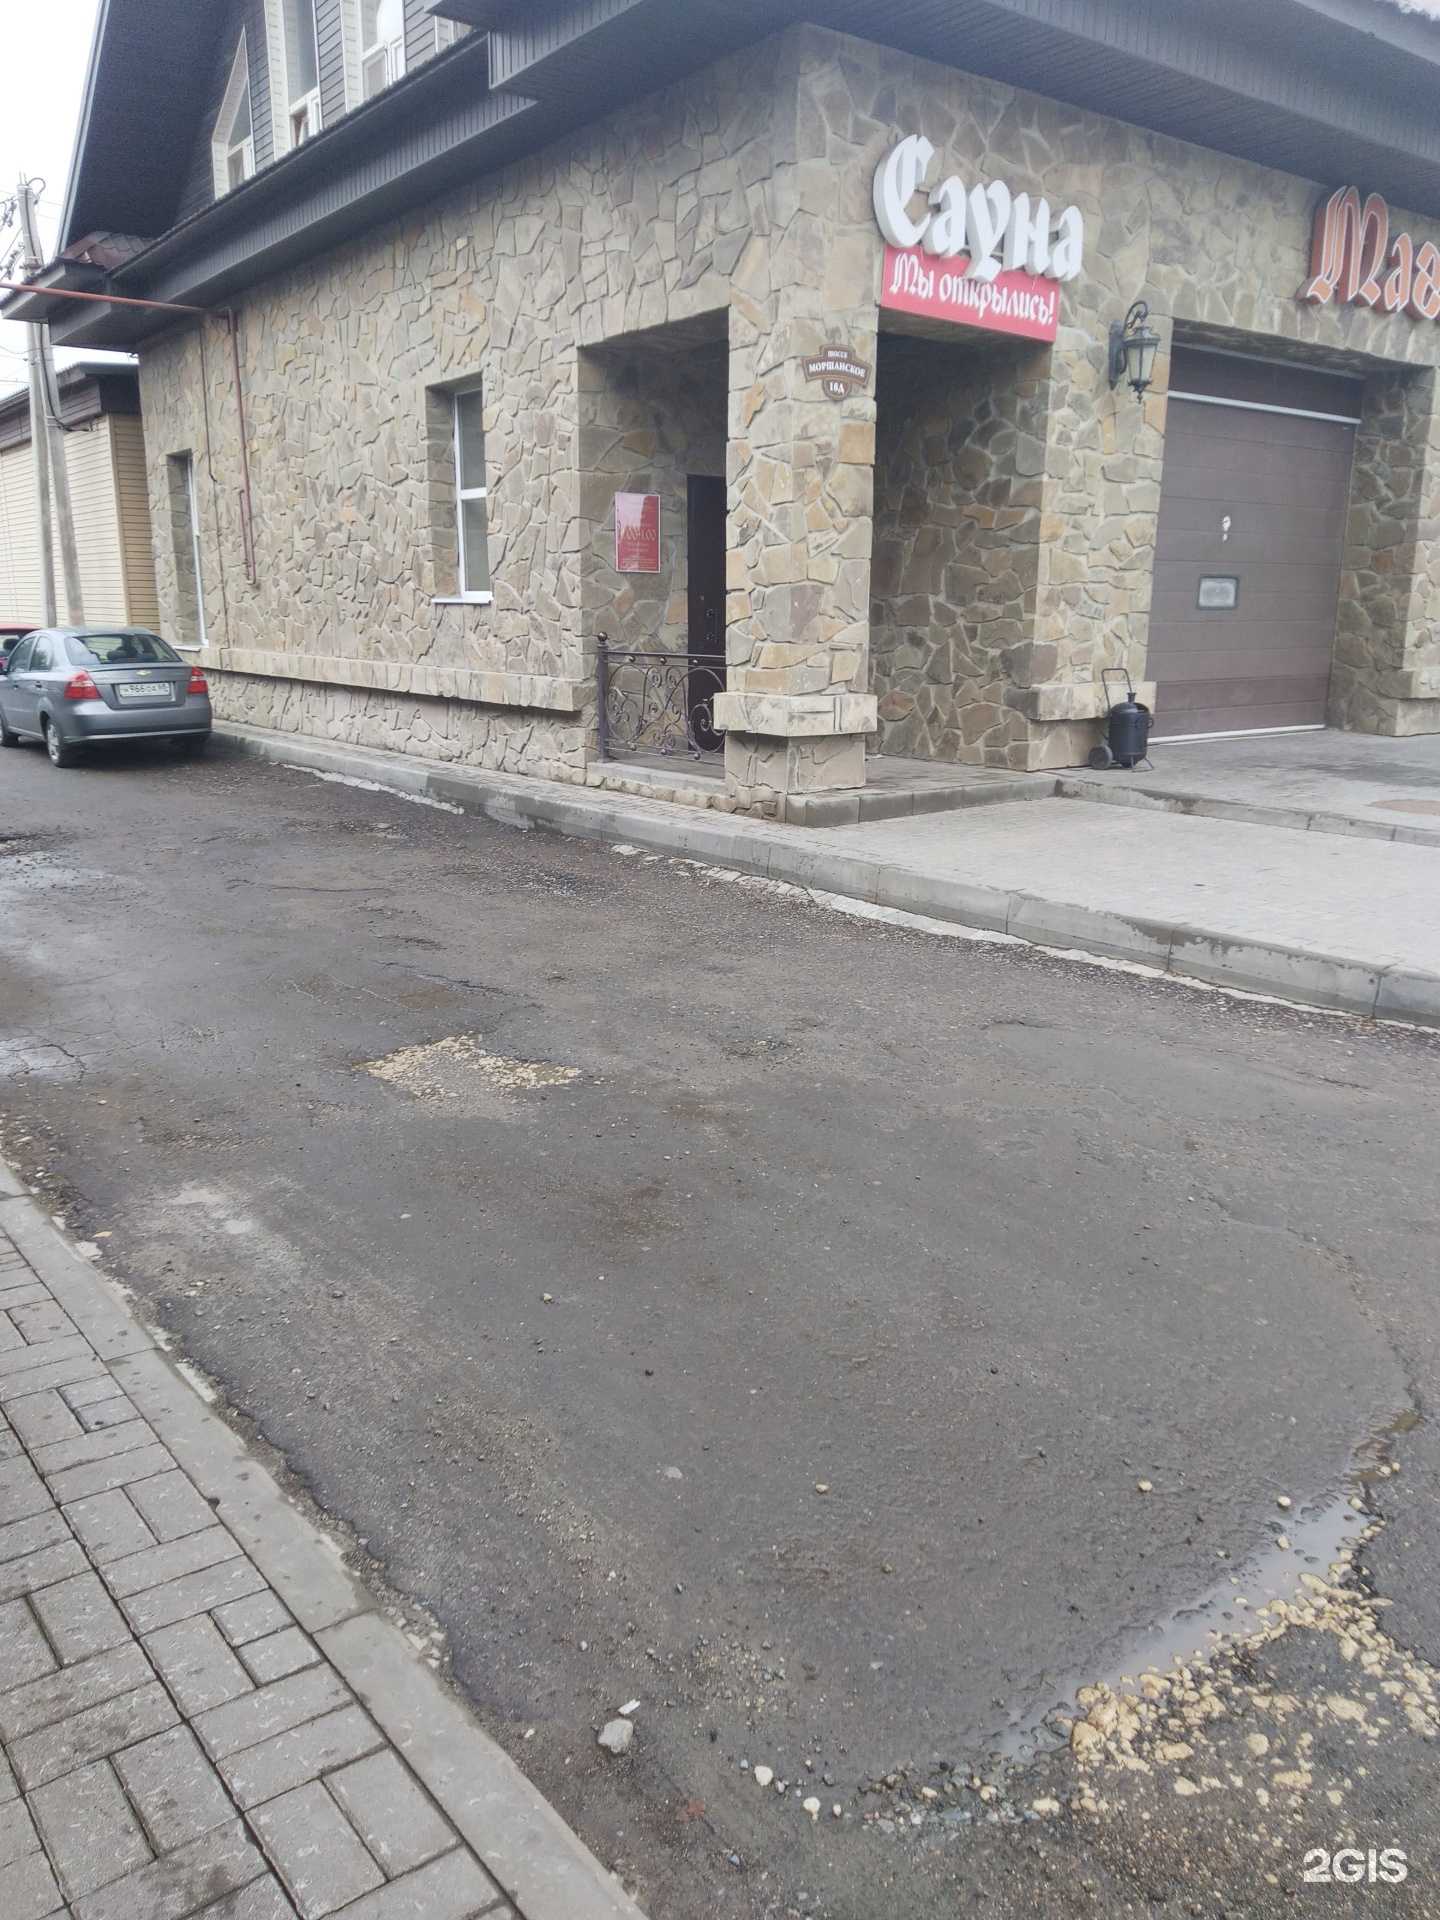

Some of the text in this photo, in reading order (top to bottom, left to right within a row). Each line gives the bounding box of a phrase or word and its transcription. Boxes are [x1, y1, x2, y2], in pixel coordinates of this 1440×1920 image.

[874, 134, 1084, 282] Сауна
[889, 252, 1055, 325] Мы открылись!
[808, 361, 865, 377] МОРШАНСКОЕ
